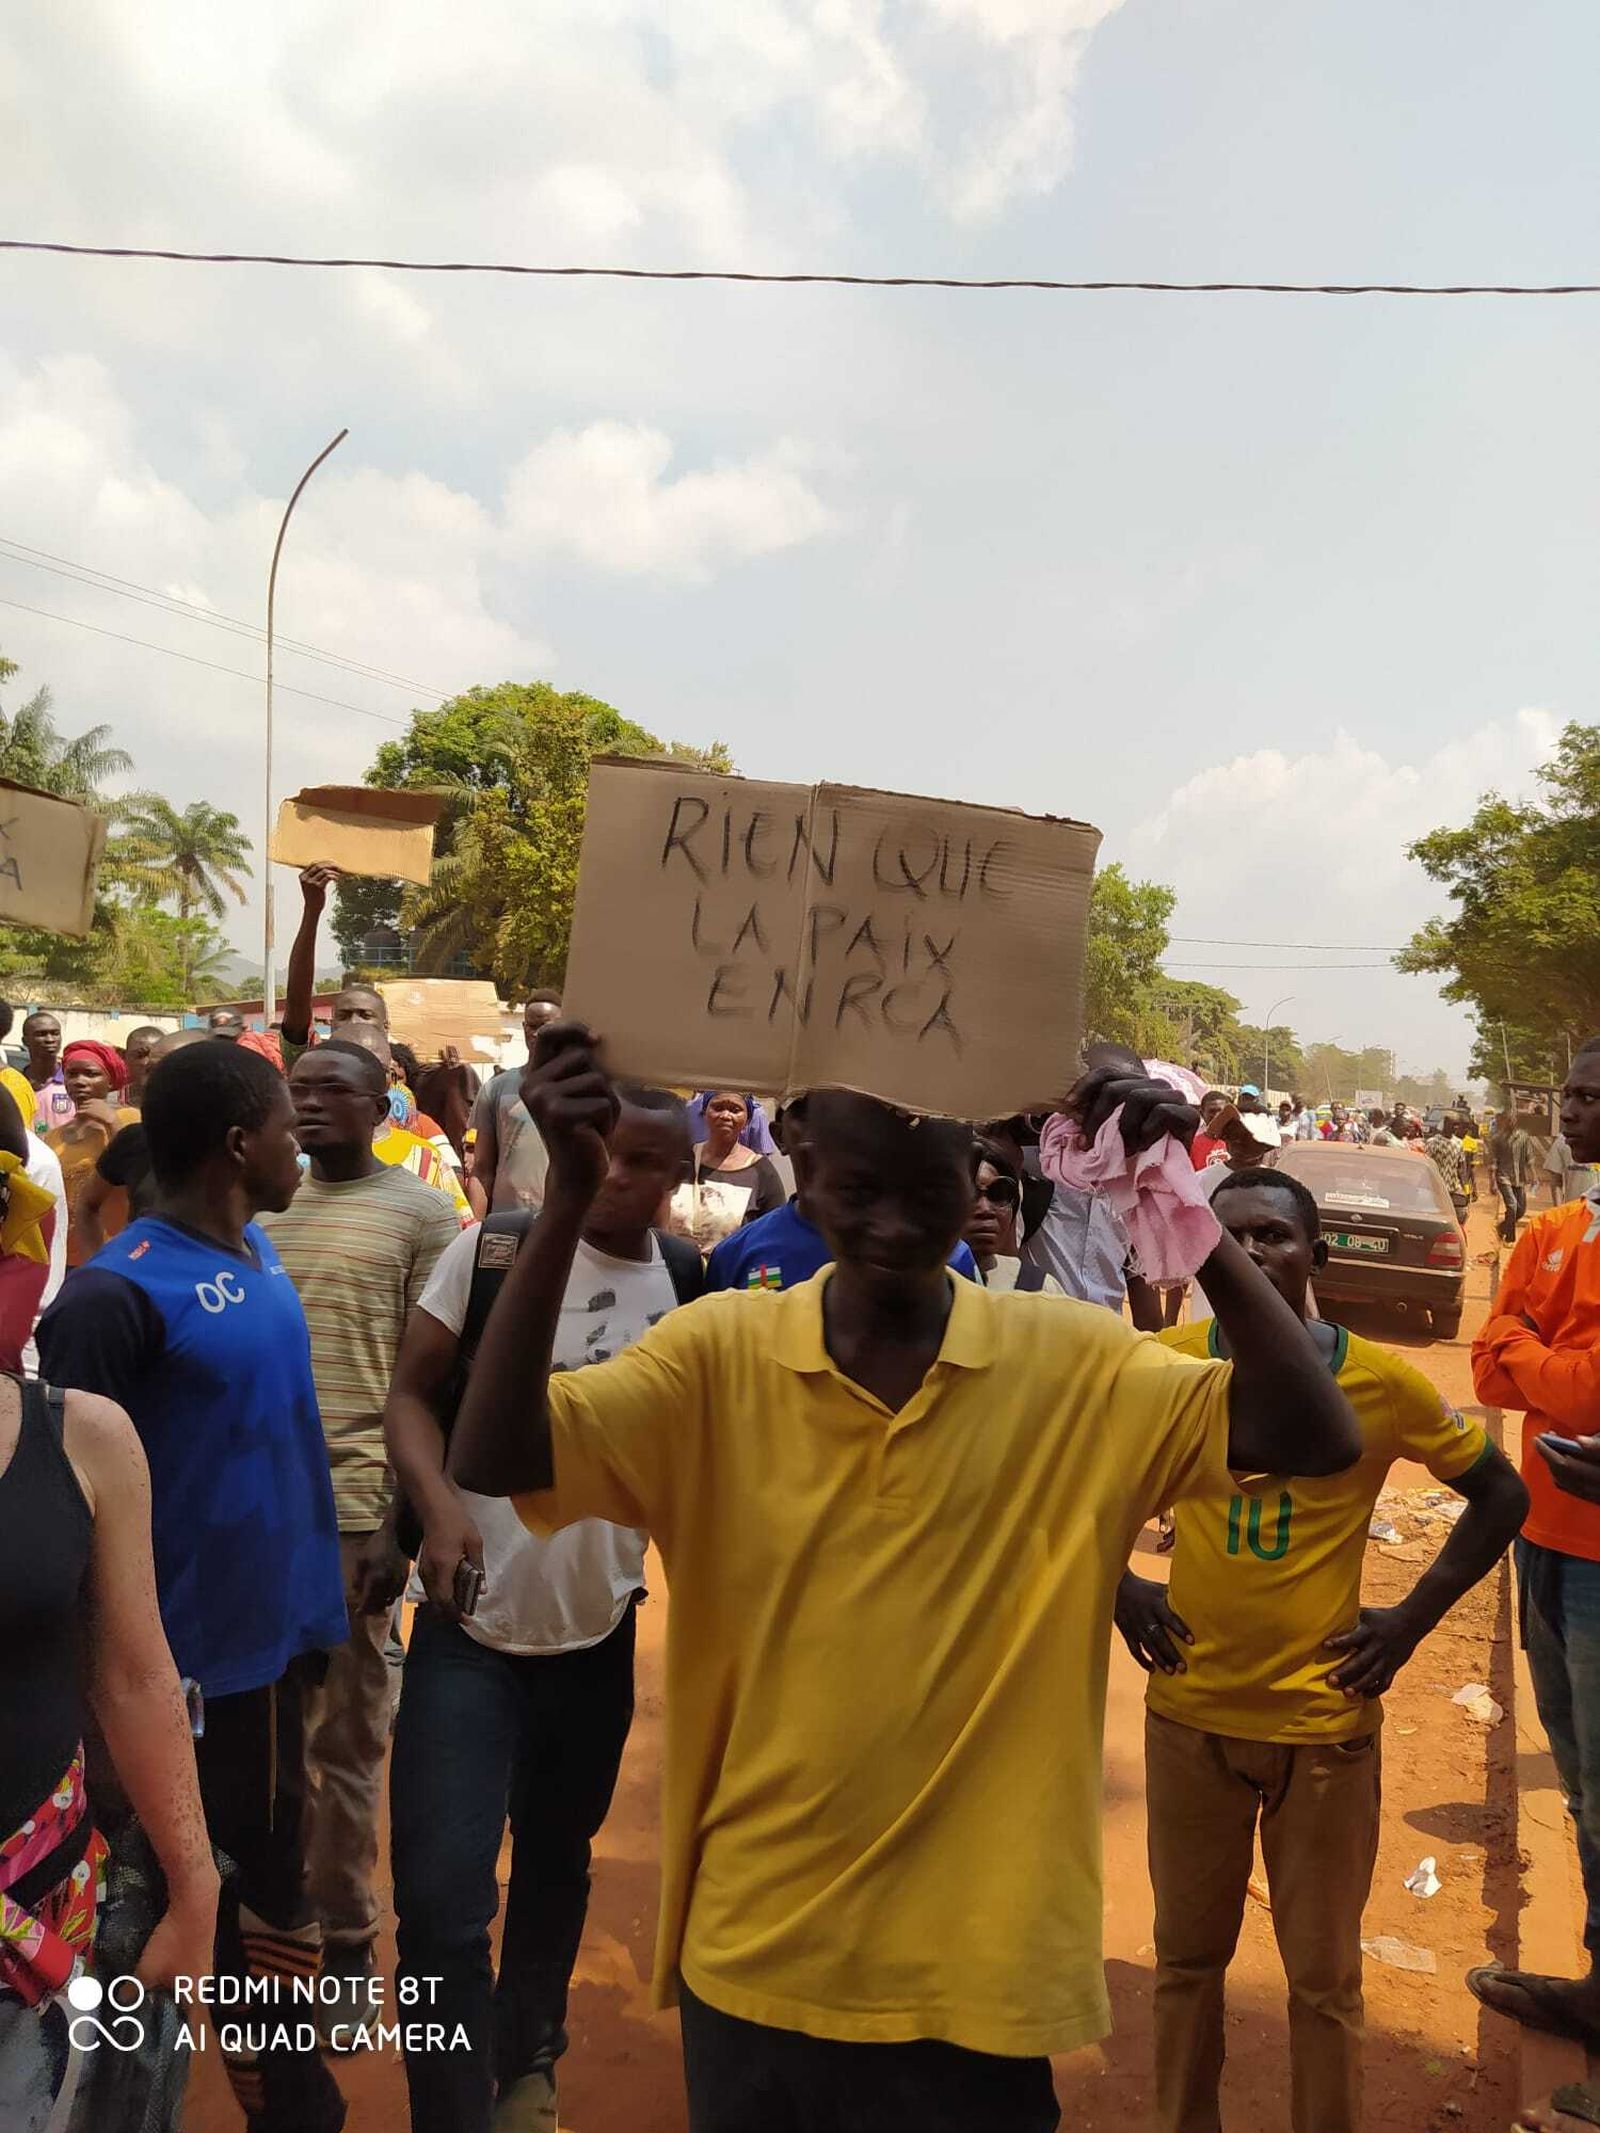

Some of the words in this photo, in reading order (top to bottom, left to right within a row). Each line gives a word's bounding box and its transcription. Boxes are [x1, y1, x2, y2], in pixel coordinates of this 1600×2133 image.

[661, 796, 840, 888] RIEN
[872, 824, 1015, 900] QUE
[692, 898, 771, 954] LA
[808, 904, 960, 976] PAIX
[707, 964, 815, 1030] EN
[836, 973, 964, 1058] RCA
[1226, 1490, 1293, 1561] 10
